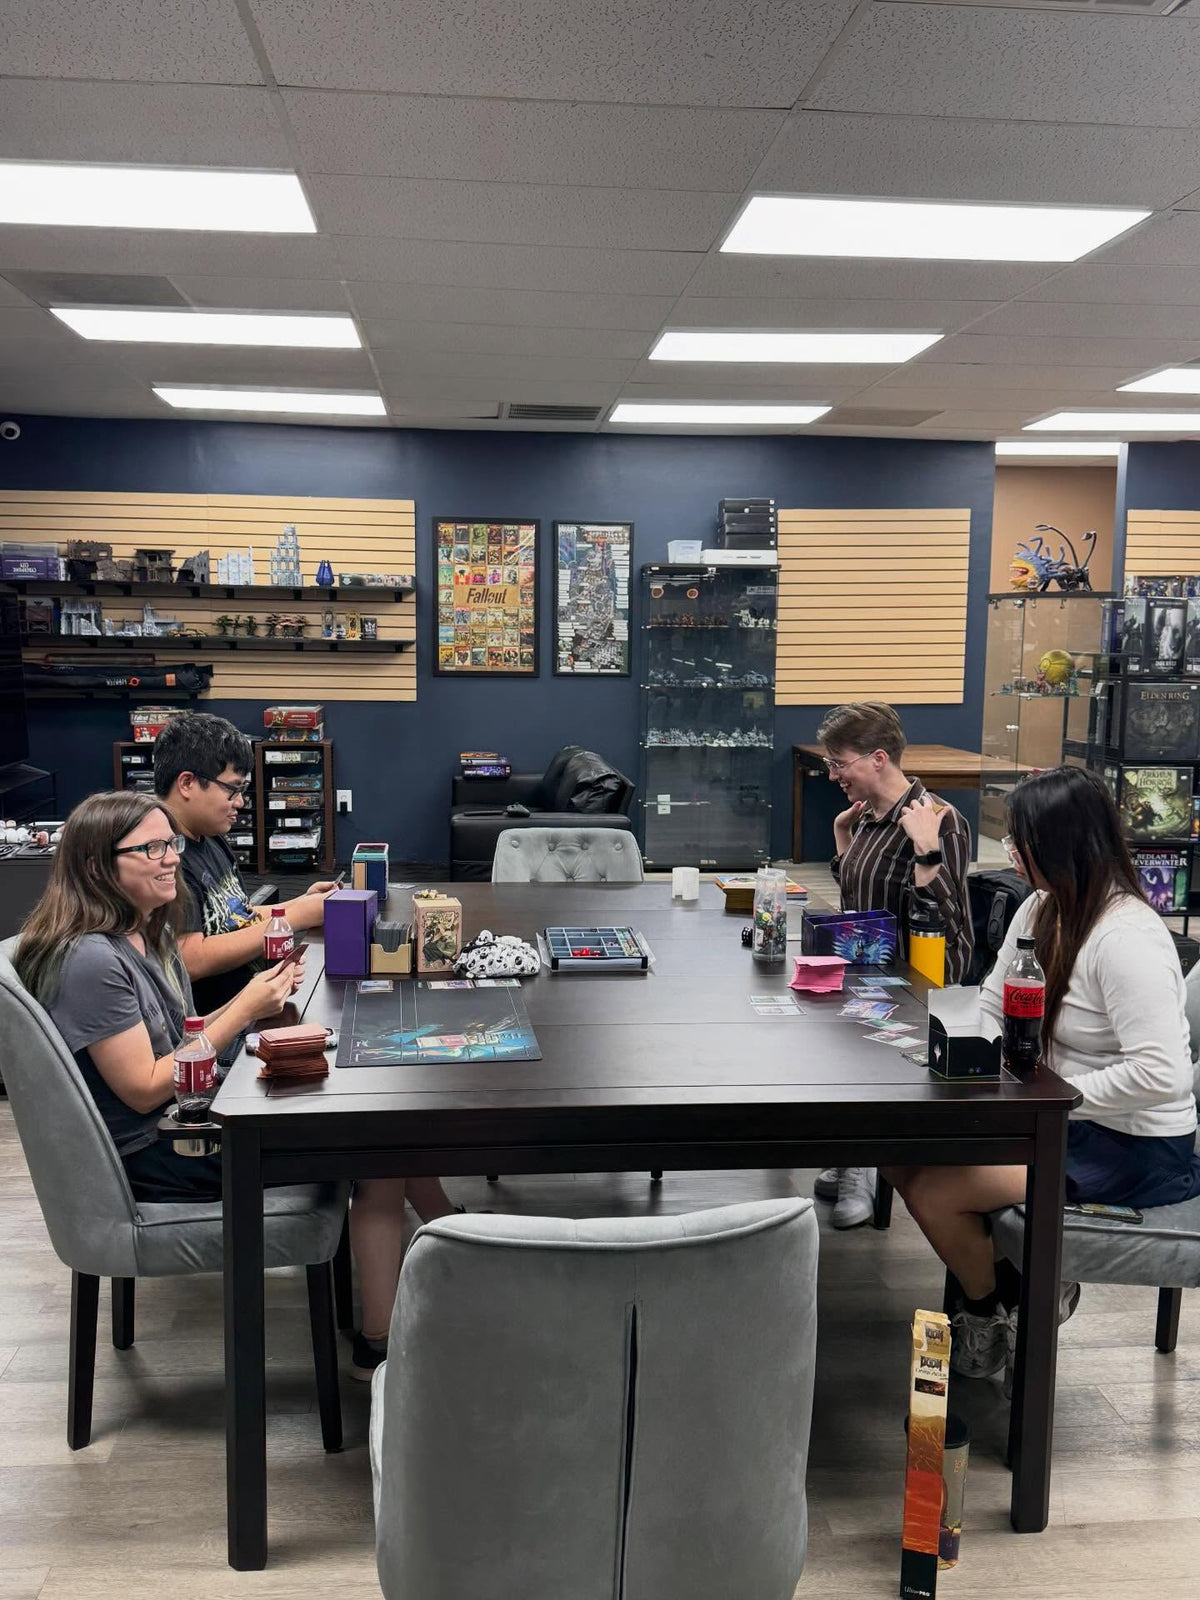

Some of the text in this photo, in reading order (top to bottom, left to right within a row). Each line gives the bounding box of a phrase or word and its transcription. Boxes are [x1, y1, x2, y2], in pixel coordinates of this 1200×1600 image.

[466, 587, 507, 604] Fallout
[1168, 691, 1190, 700] RING
[1141, 770, 1173, 778] ARKHAM
[920, 1355, 942, 1372] DOOM
